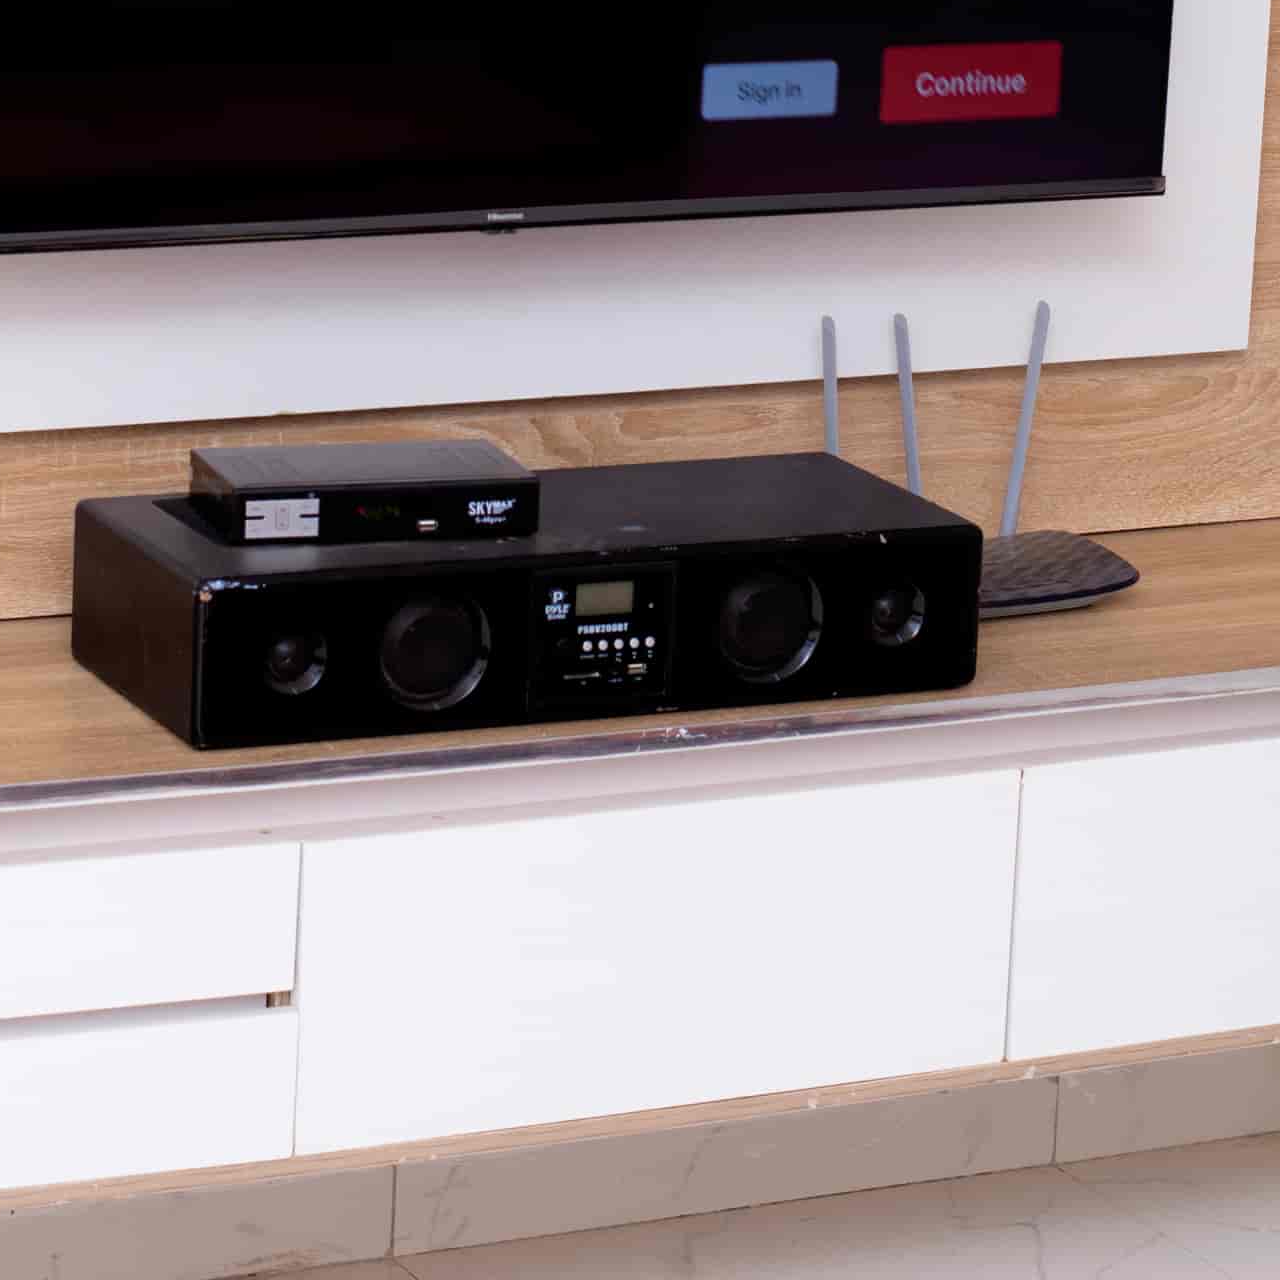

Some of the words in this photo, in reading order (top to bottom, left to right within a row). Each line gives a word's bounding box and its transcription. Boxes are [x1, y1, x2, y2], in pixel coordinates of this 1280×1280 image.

[737, 78, 782, 105] Sign
[785, 78, 802, 98] in
[915, 69, 1027, 99] Continue
